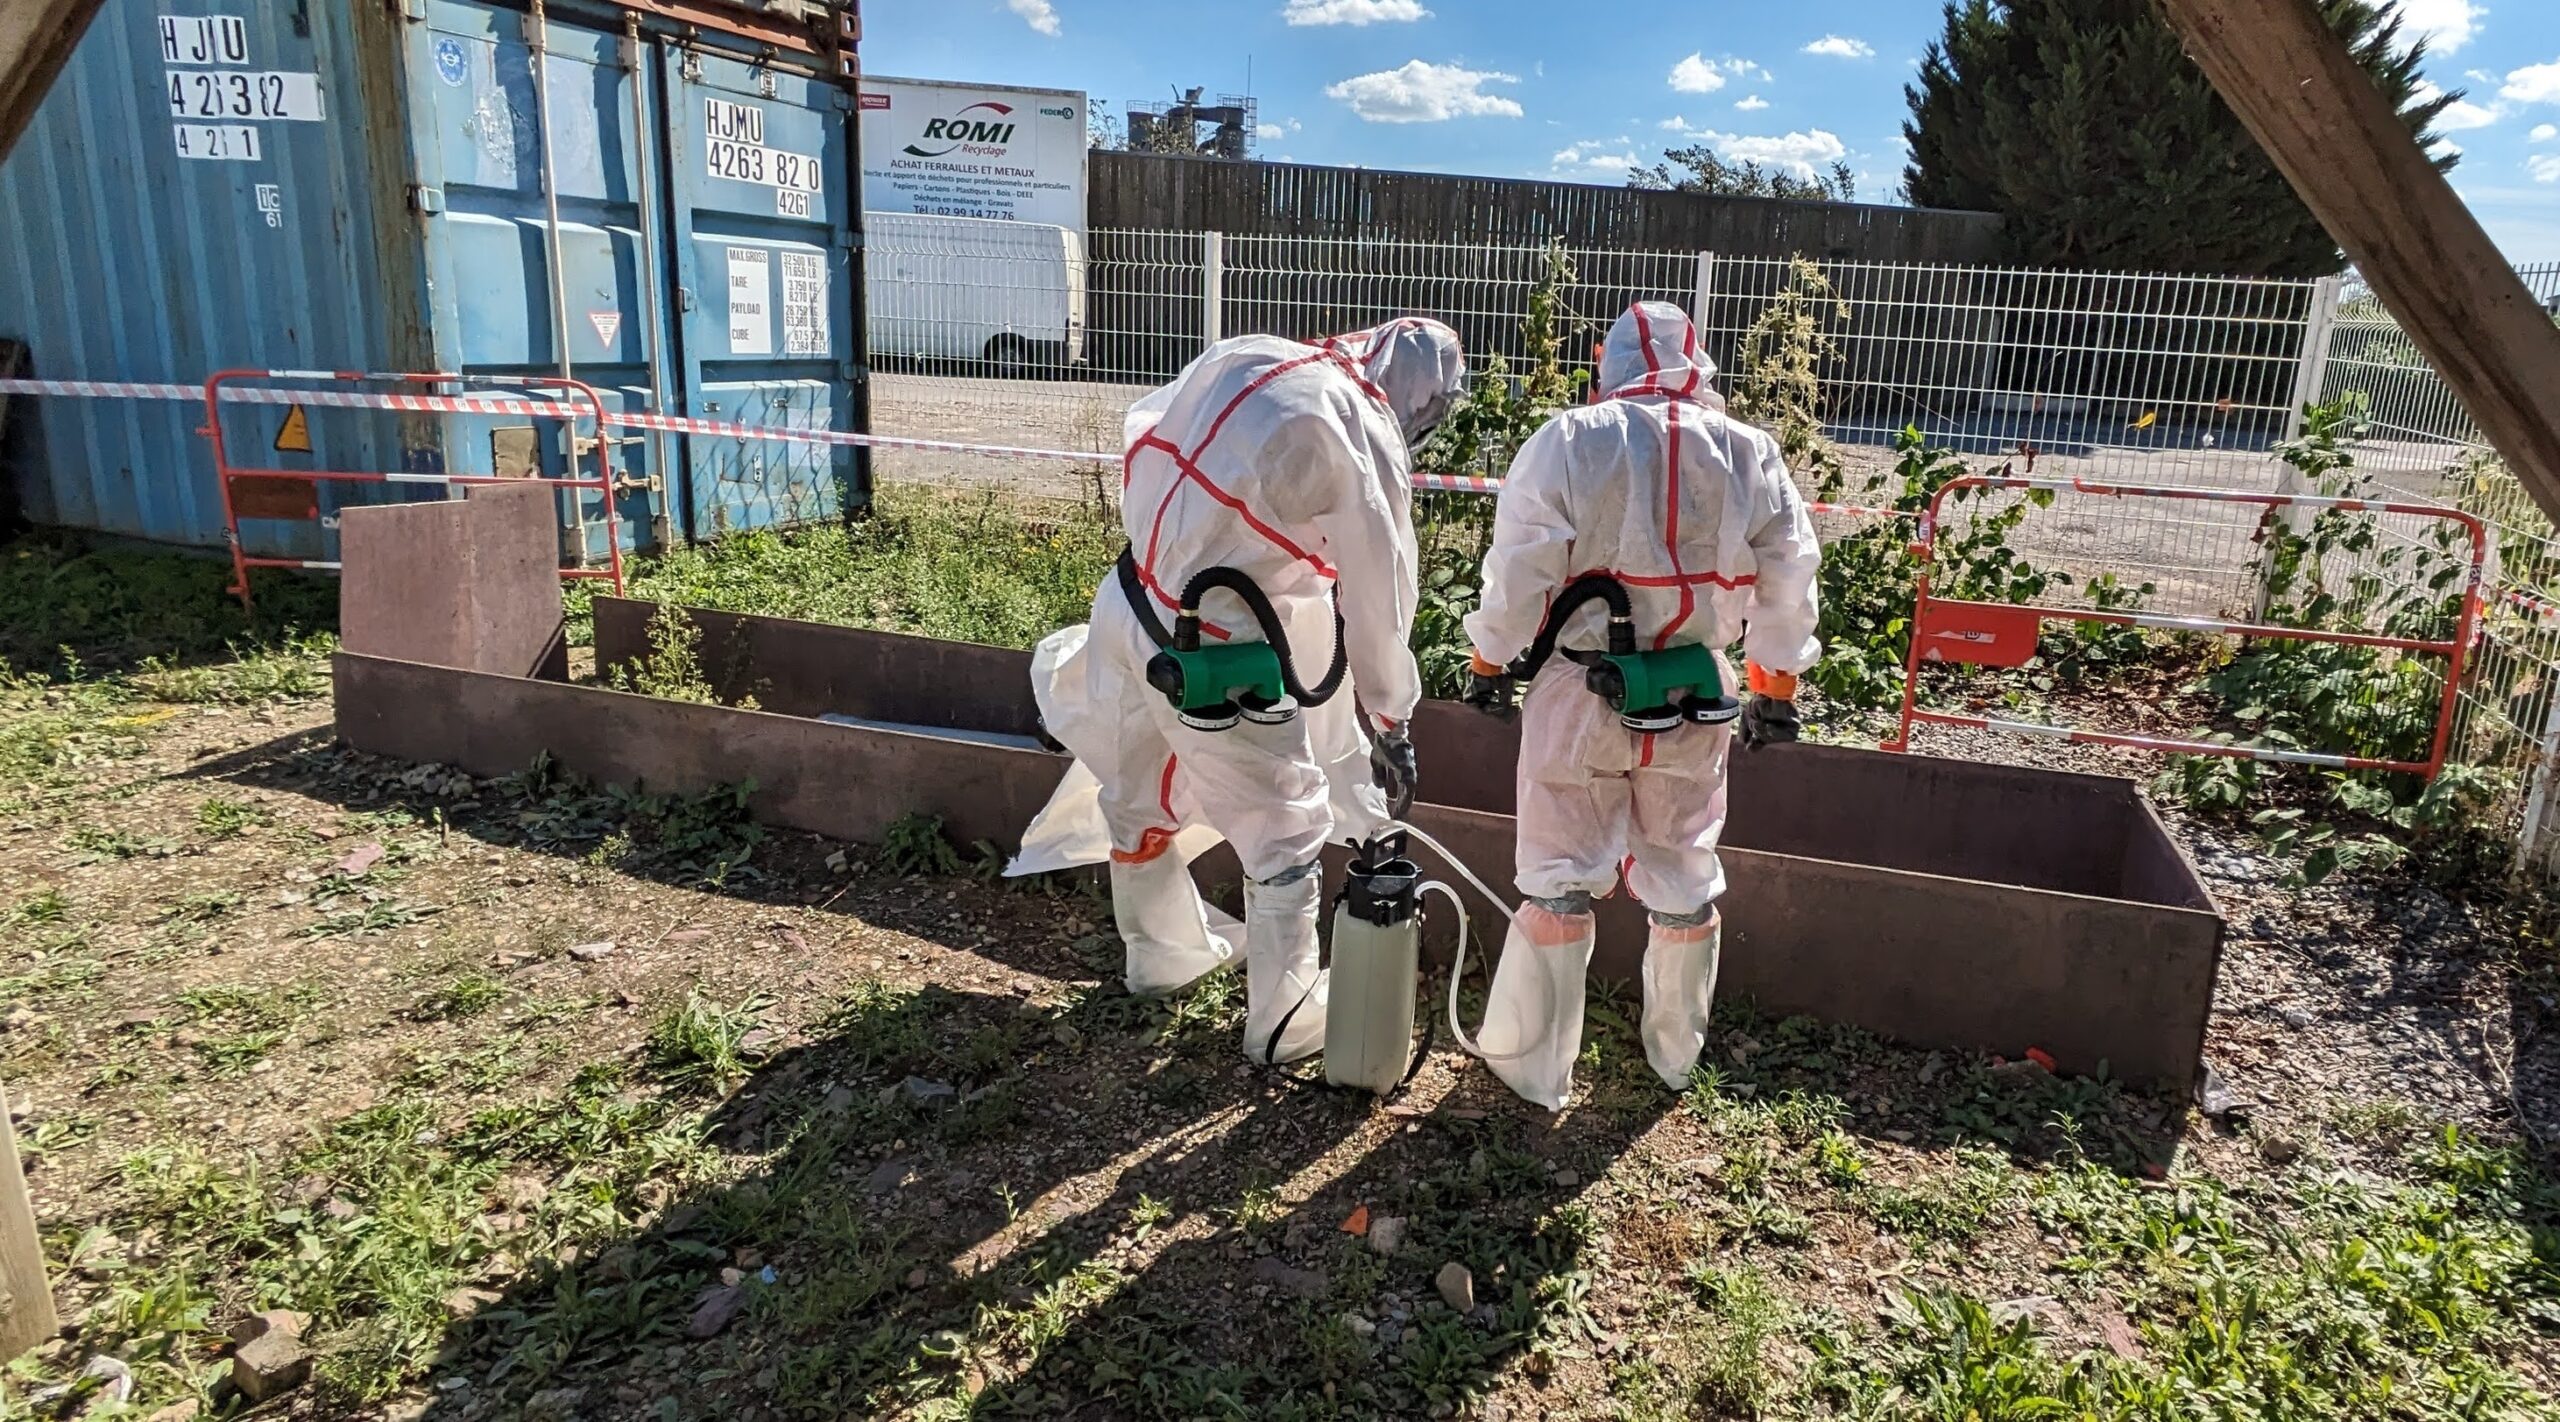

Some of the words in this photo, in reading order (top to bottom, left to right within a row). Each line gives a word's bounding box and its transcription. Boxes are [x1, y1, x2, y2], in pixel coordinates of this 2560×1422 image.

[707, 100, 762, 142] HJMU
[923, 118, 1016, 143] ROMI
[962, 144, 1007, 158] Recyclage
[709, 142, 763, 181] 4263
[777, 154, 800, 188] 82
[890, 160, 922, 170] ACHAT
[925, 162, 979, 174] FERRAILLES
[981, 166, 992, 175] ET
[994, 167, 1035, 177] METAUX
[893, 171, 916, 180] apport
[928, 173, 955, 182] déchets
[956, 177, 972, 185] pour
[974, 177, 1023, 188] professionnels
[1033, 182, 1071, 191] particuliers
[893, 182, 918, 191] Papiers
[924, 184, 950, 193] Cartons
[956, 186, 991, 195] Plastiques
[996, 189, 1011, 197] Bois
[779, 191, 808, 216] 42G1
[914, 194, 941, 203] Déchets
[952, 196, 982, 206] mélange
[988, 199, 1014, 208] Gravats
[266, 212, 283, 228] 61
[913, 205, 928, 215] Tél
[937, 207, 950, 216] 02
[953, 207, 967, 217] 99
[970, 209, 983, 219] 14
[985, 210, 999, 220] 77
[1001, 211, 1015, 221] 76
[807, 257, 817, 268] KG
[808, 267, 817, 279] LB
[731, 276, 748, 288] TARE
[809, 282, 818, 292] KG
[731, 302, 760, 315] PAYLOAD
[732, 328, 750, 340] CUBE
